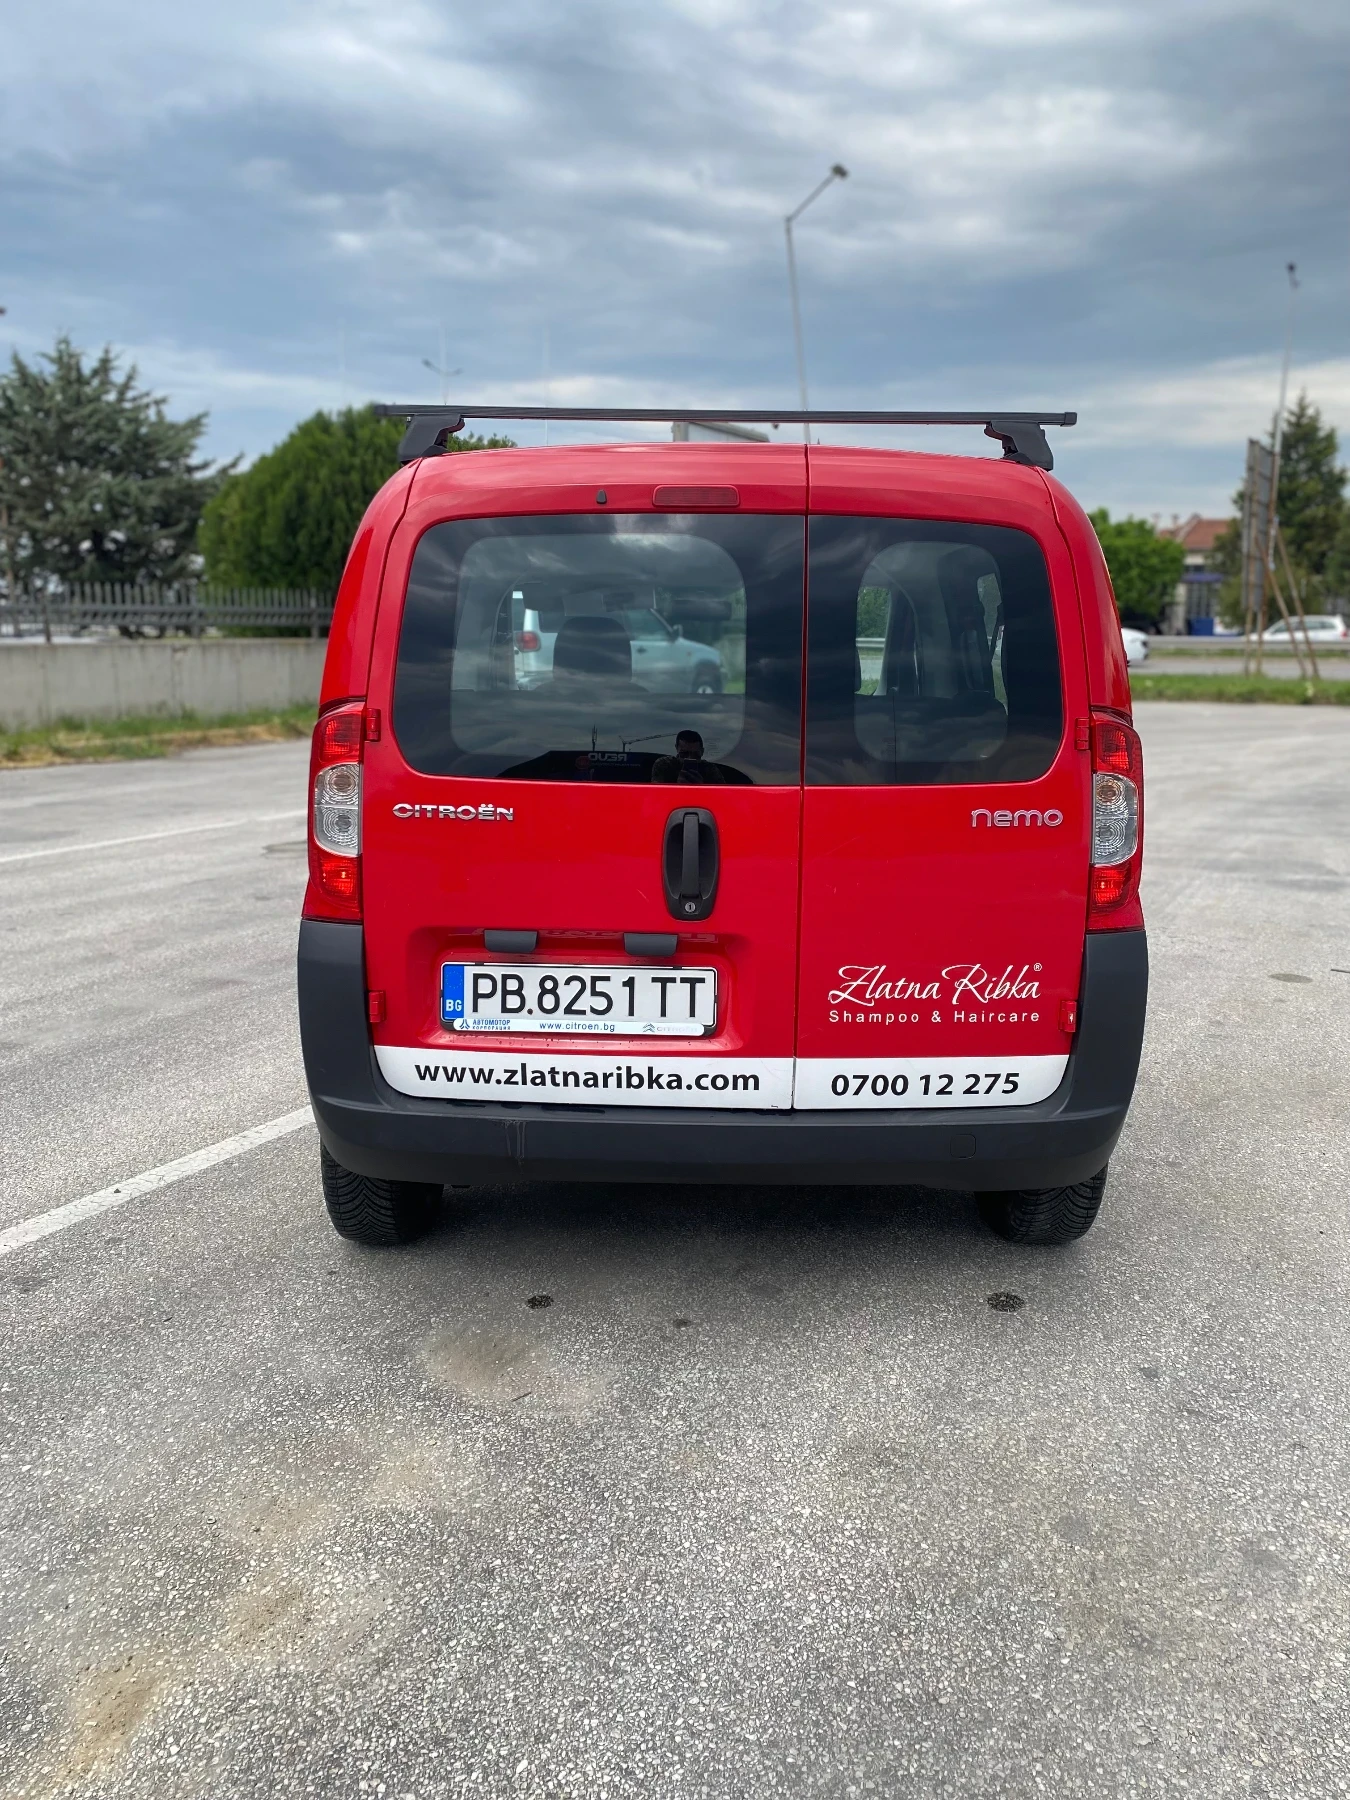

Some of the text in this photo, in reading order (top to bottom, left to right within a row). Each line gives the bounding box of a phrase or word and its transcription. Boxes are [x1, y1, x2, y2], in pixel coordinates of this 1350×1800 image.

[392, 803, 514, 821] CITROËN
[971, 808, 1063, 827] nemo
[827, 964, 941, 1006] Zlatna
[446, 999, 462, 1012] BG
[472, 1018, 511, 1026] АВТОМОТОР
[539, 1021, 615, 1032] www.citroen.bg
[828, 1010, 1040, 1026] Shampoo & Haircare
[414, 1062, 760, 1091] www.zlatnaribka.com
[831, 1072, 1020, 1096] 0700 12 275
